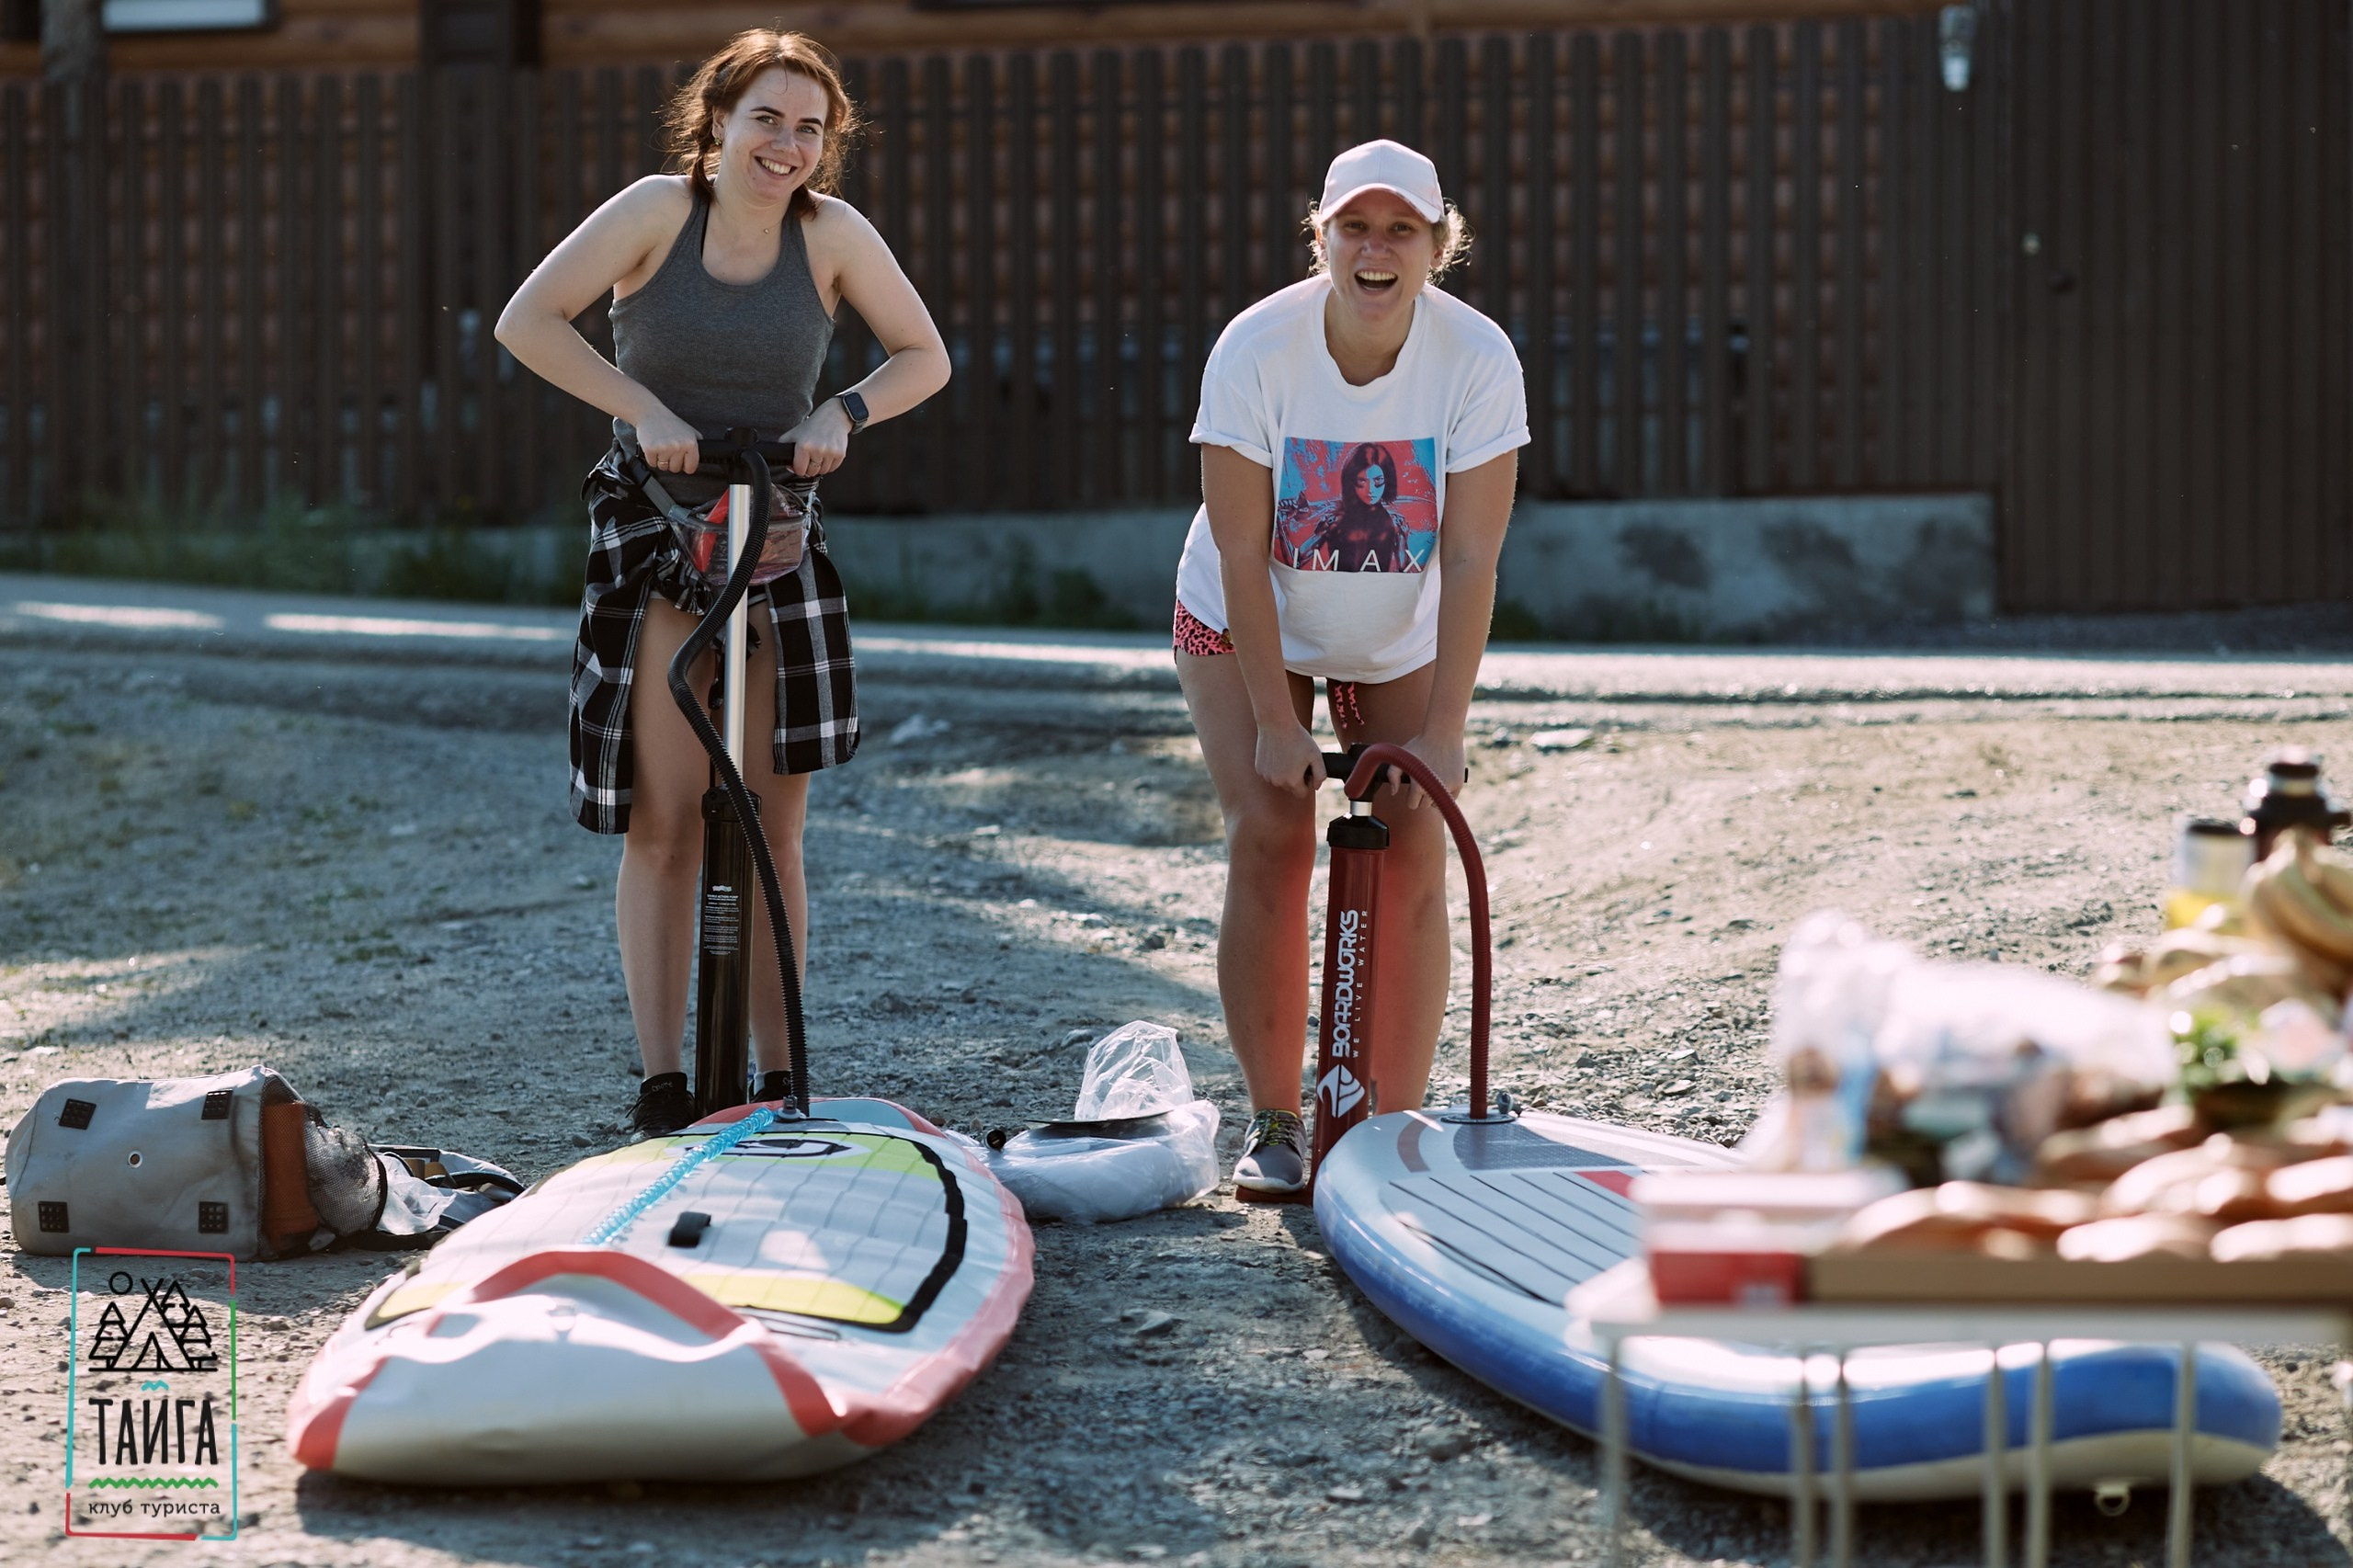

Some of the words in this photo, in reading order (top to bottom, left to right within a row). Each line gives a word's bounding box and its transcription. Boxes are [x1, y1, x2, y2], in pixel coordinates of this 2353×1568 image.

[1292, 547, 1425, 574] IMAX
[1358, 910, 1369, 967] WATER
[1332, 909, 1358, 1058] BOARDWORKS
[1354, 982, 1363, 1022] LIVE
[1352, 1037, 1360, 1058] WE
